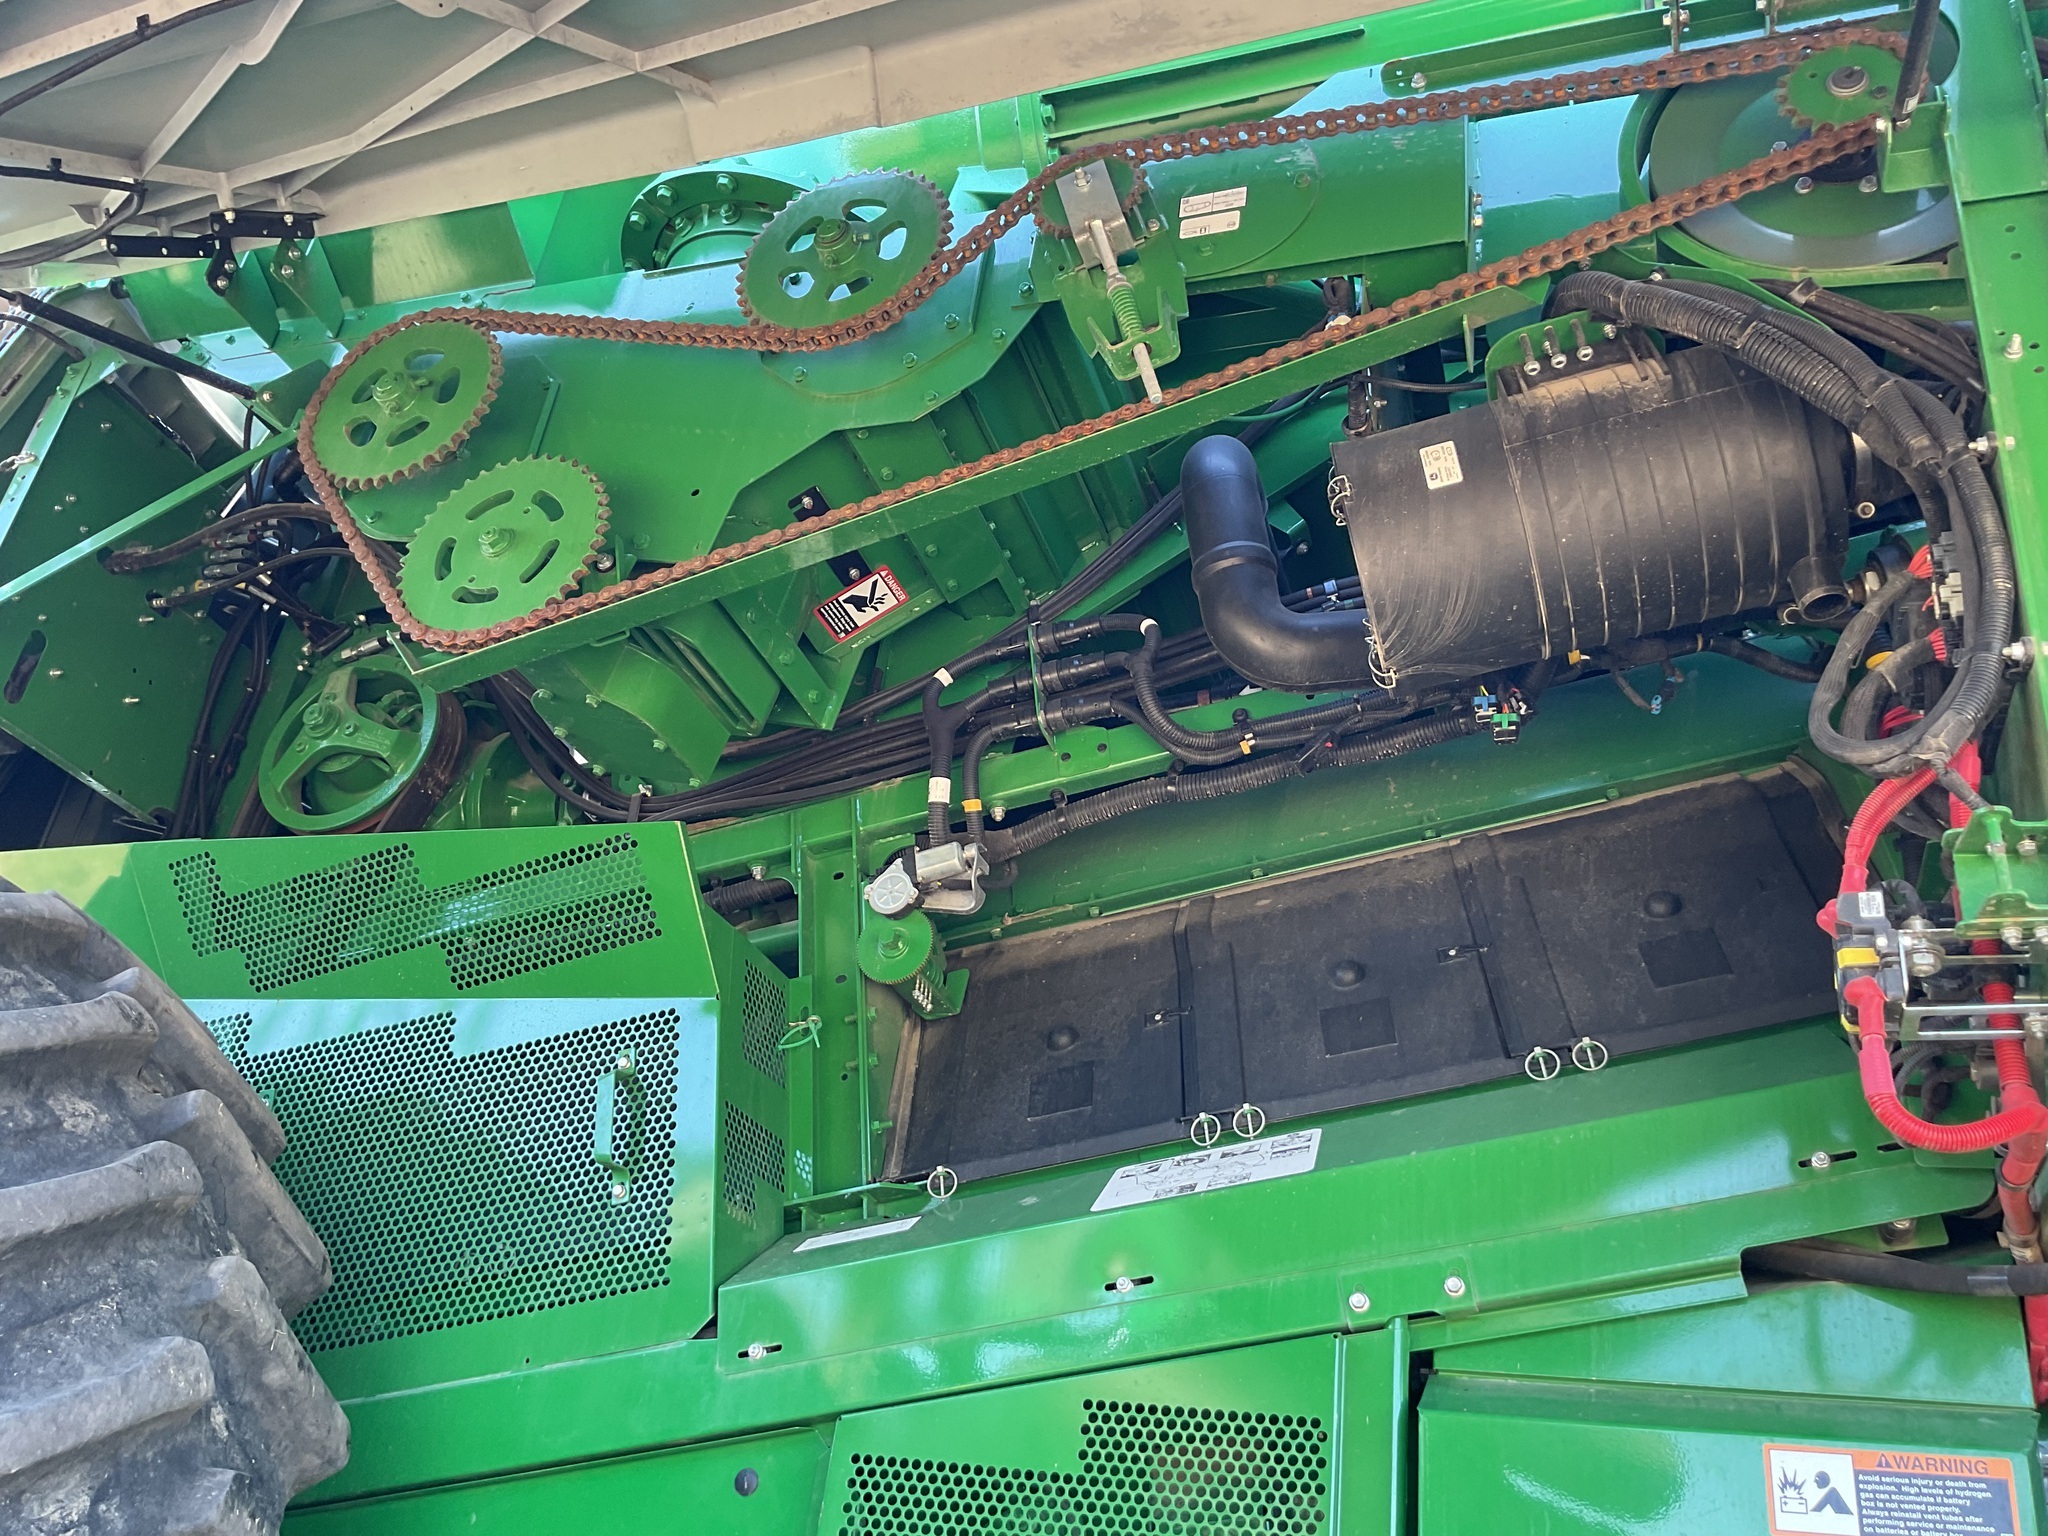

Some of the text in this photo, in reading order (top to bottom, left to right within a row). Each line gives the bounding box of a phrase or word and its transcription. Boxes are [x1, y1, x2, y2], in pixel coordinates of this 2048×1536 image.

[885, 575, 906, 601] DANGER
[1893, 1455, 1989, 1475] WARNING
[1911, 1477, 1933, 1486] injury
[1859, 1484, 1898, 1492] explosion.
[1902, 1486, 1920, 1494] High
[1955, 1489, 1992, 1499] hydrogen
[1891, 1494, 1935, 1502] accumulate
[1943, 1497, 1970, 1506] battery
[1862, 1508, 1890, 1518] Always
[1928, 1506, 1962, 1514] properly.
[1862, 1518, 1905, 1528] performing
[1906, 1520, 1935, 1528] service
[1946, 1523, 1996, 1532] maintenance
[1875, 1526, 1910, 1536] batteries
